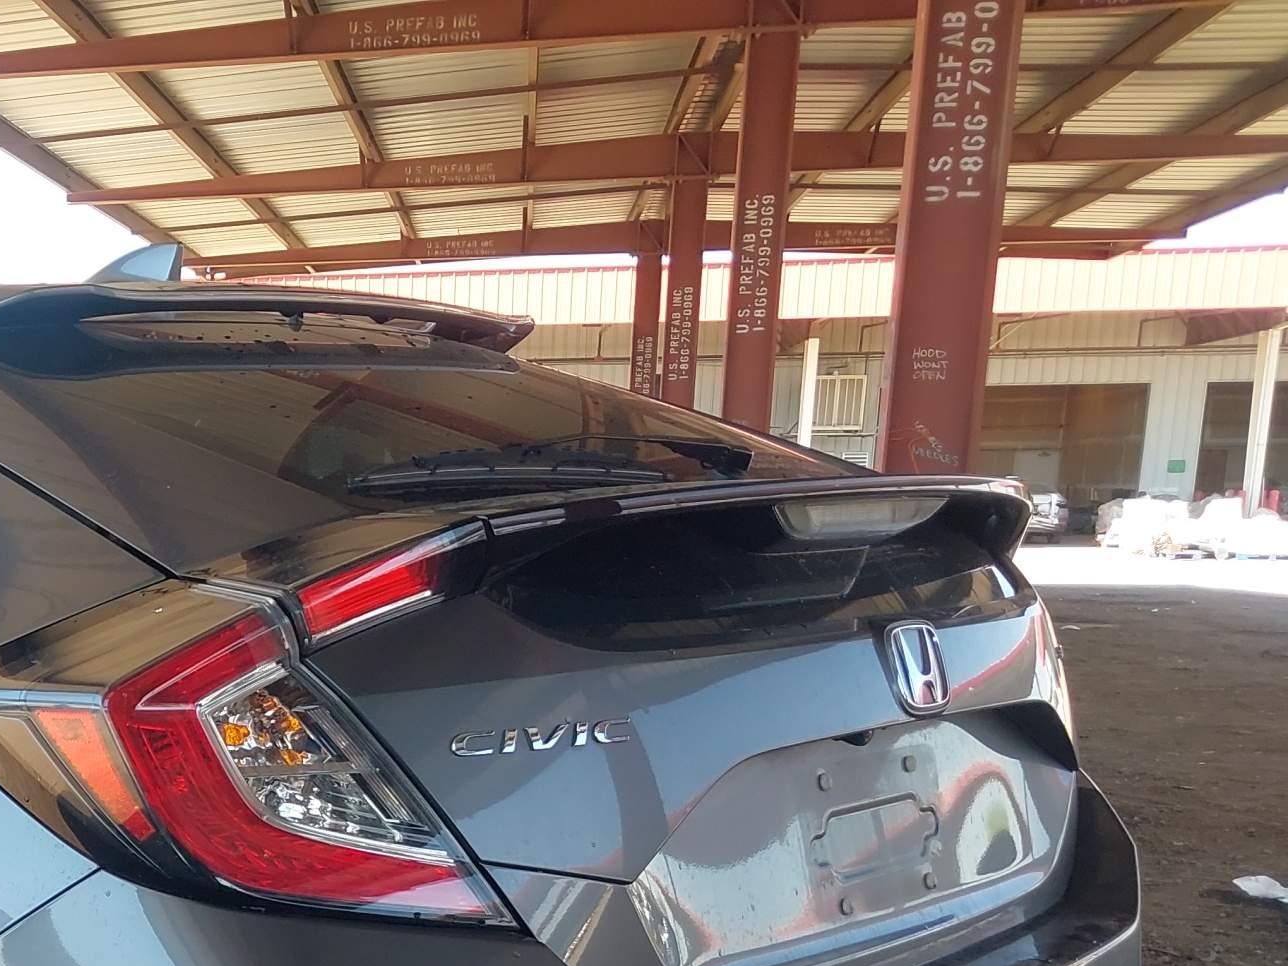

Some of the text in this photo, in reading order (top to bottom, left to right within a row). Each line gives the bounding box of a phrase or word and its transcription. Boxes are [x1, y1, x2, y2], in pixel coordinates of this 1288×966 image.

[386, 16, 445, 33] PREFAB
[924, 11, 967, 202] U.S. PREFAB
[739, 233, 756, 295] PREFAB
[753, 194, 775, 331] 1-866-799-0969
[670, 312, 681, 355] PREFAB
[679, 286, 694, 379] 1-866-799-0969
[736, 303, 751, 334] U.S.
[912, 346, 947, 360] HOOD
[913, 360, 949, 369] WONT
[449, 712, 631, 758] CIVIC
